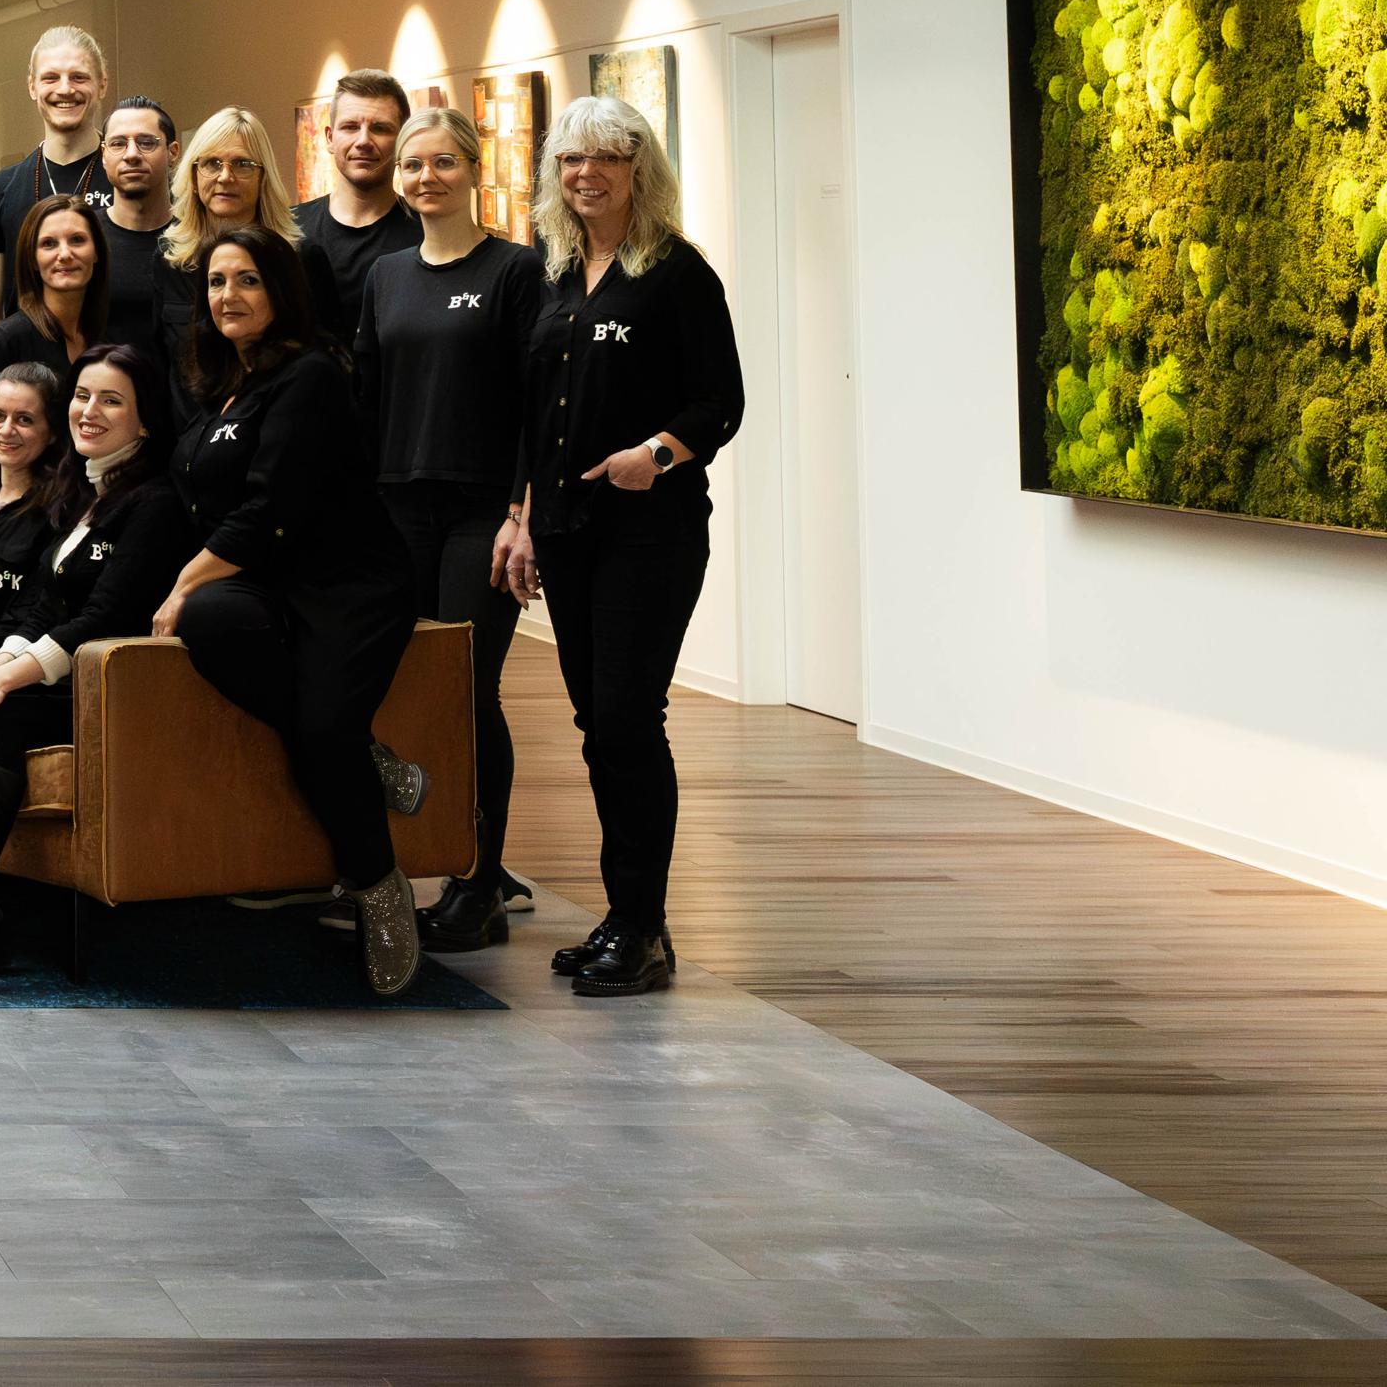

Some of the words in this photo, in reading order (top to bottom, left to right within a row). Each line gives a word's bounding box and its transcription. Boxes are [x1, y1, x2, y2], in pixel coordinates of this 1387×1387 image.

[84, 190, 112, 207] B&K
[447, 292, 482, 310] B&K
[592, 320, 632, 343] B&K
[209, 423, 239, 443] B&K
